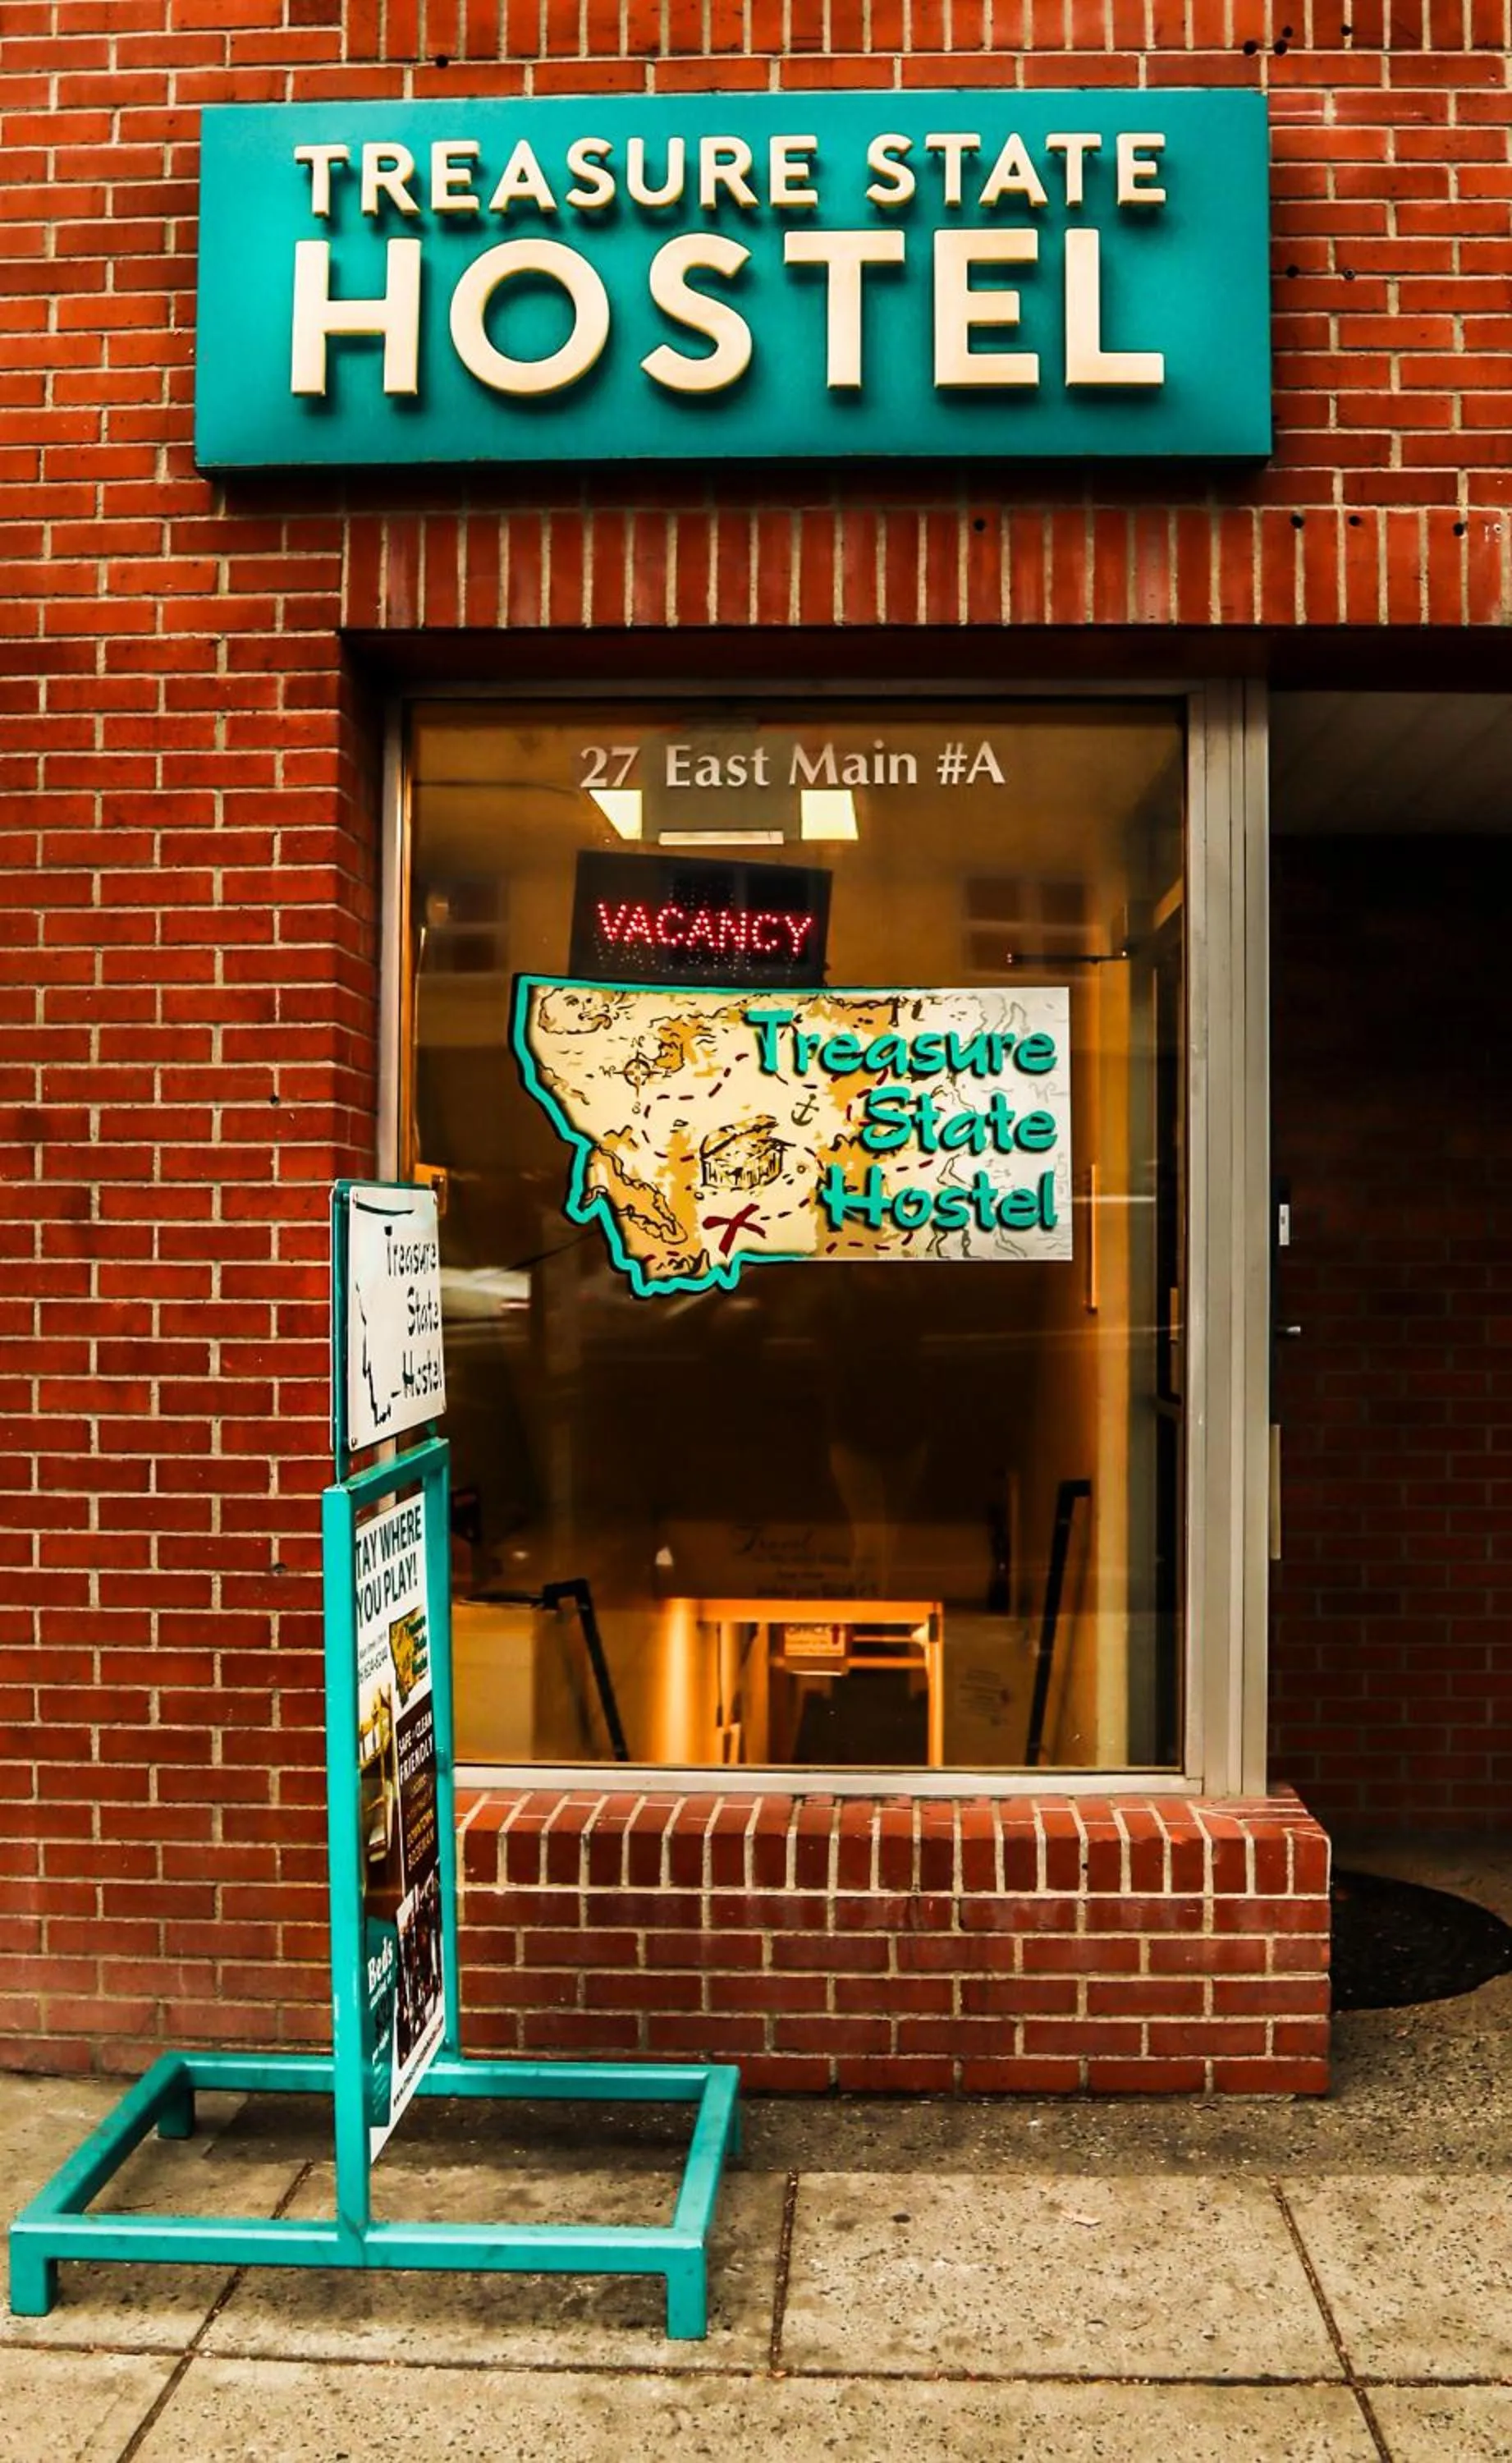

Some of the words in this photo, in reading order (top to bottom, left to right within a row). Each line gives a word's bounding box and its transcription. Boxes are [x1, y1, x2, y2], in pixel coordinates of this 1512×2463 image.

[293, 133, 820, 219] TREASURE
[866, 131, 1168, 211] STATE
[289, 225, 1167, 399] HOSTEL
[580, 745, 640, 788] 27
[665, 744, 770, 787] East
[788, 739, 918, 786] Main
[936, 741, 1006, 785] #A
[596, 901, 814, 956] VACANCY
[745, 1008, 1059, 1076] Treasure
[860, 1085, 1059, 1154] State
[819, 1163, 1059, 1232] Hostel
[384, 1226, 437, 1276] Treasure
[406, 1286, 440, 1337] State
[401, 1349, 443, 1399] Hostel
[355, 1530, 378, 1580] TAY
[379, 1504, 422, 1562] WHERE
[355, 1575, 383, 1629] YOU
[383, 1552, 418, 1608] PLAY!
[367, 1935, 394, 1994] Beds
